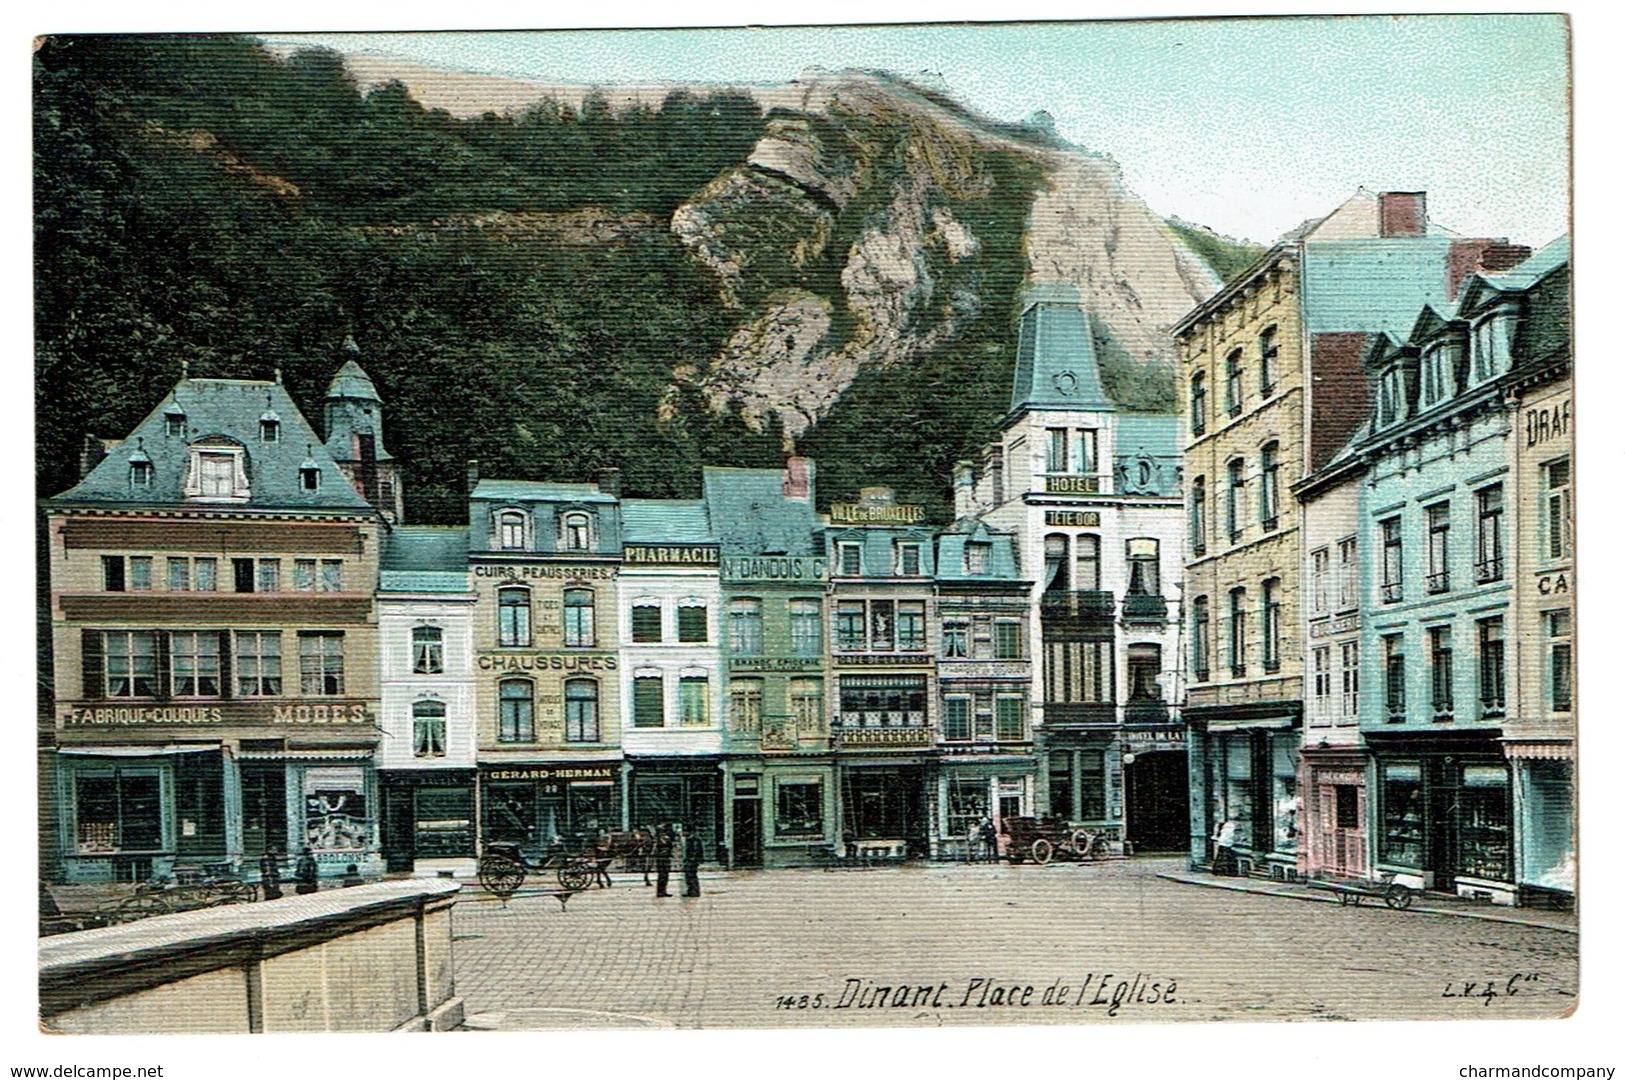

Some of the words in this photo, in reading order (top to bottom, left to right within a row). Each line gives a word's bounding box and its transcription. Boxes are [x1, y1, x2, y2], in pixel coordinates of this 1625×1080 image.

[1051, 478, 1094, 492] HOTEL
[831, 505, 859, 521] VILLE
[869, 507, 926, 521] BRUXELLES
[625, 547, 719, 562] PHARMACIE
[741, 559, 802, 578] DANDOIS
[477, 656, 617, 671] CHAUSSURES
[72, 708, 147, 724] FABRIQUE
[154, 707, 222, 723] COUQUES
[273, 704, 366, 723] MODES
